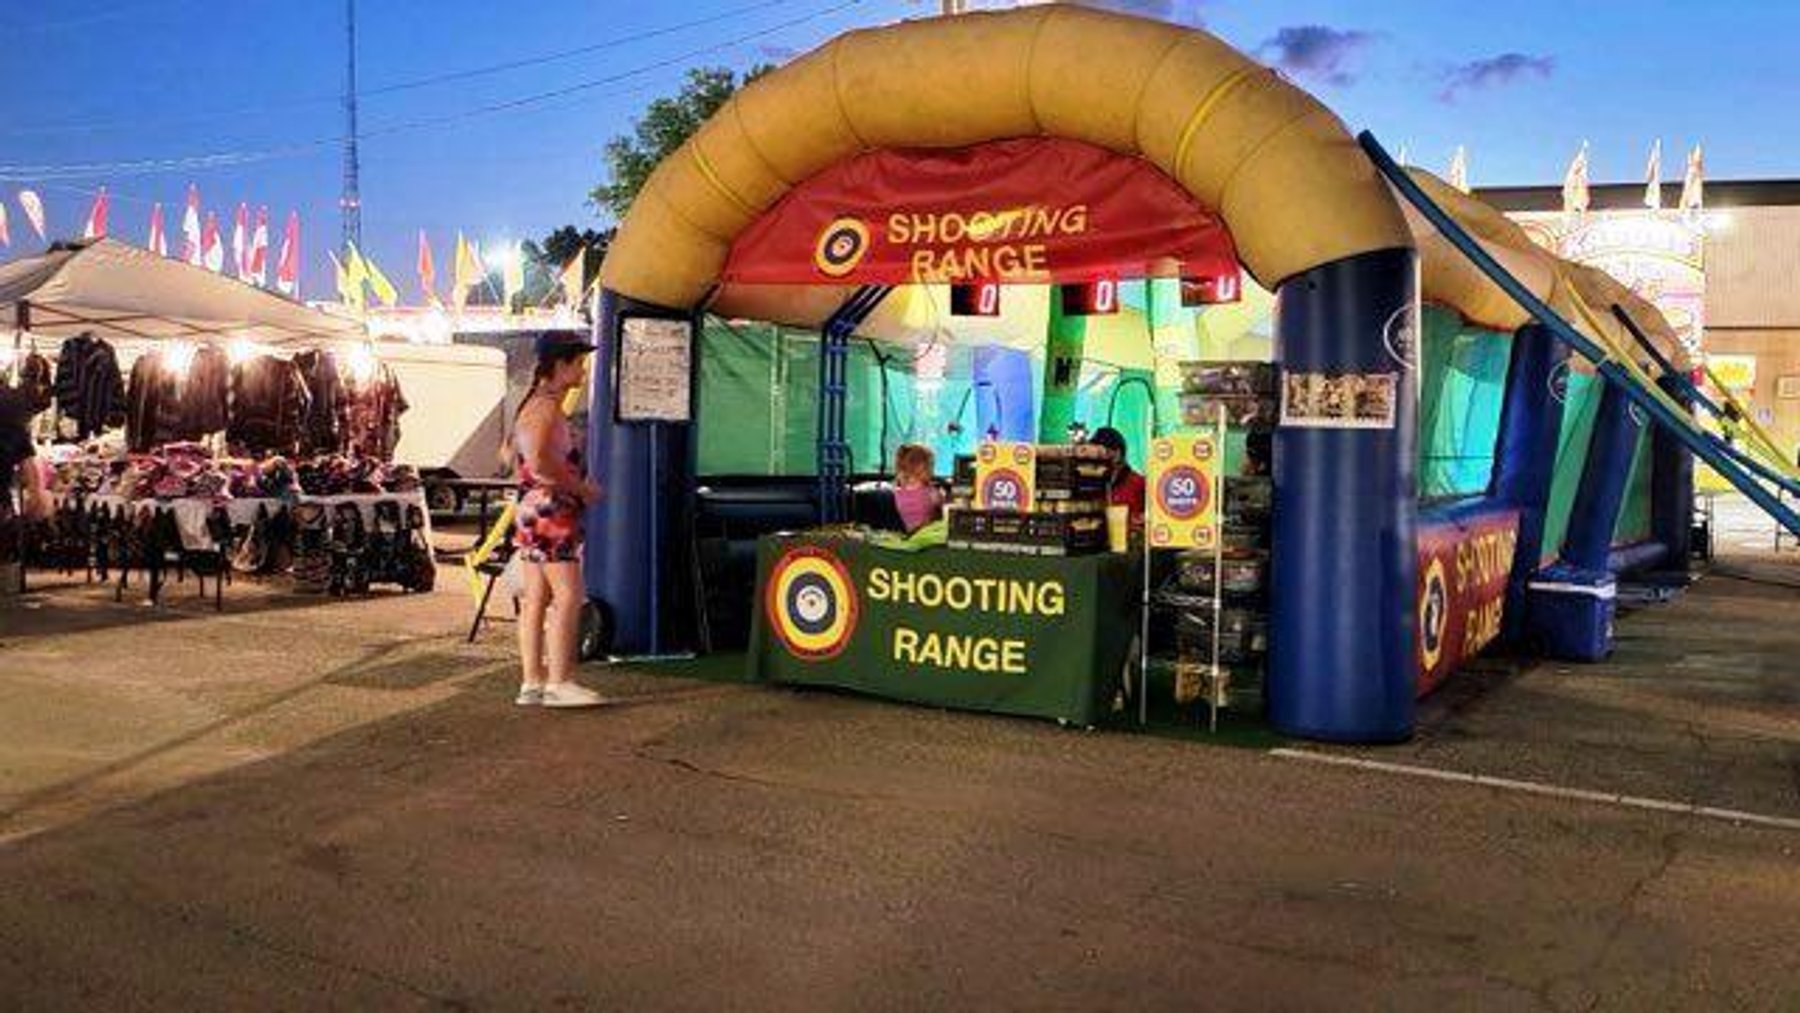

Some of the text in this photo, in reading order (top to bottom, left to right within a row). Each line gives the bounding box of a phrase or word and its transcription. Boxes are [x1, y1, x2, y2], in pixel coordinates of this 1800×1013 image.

[888, 205, 1087, 244] SHOOTING
[912, 245, 1050, 284] RANGE
[978, 284, 998, 314] 0
[1095, 280, 1113, 311] 0
[993, 480, 1017, 499] 50
[1169, 477, 1195, 496] 50
[866, 567, 1066, 615] SHOOTING
[893, 627, 1027, 674] RANGE
